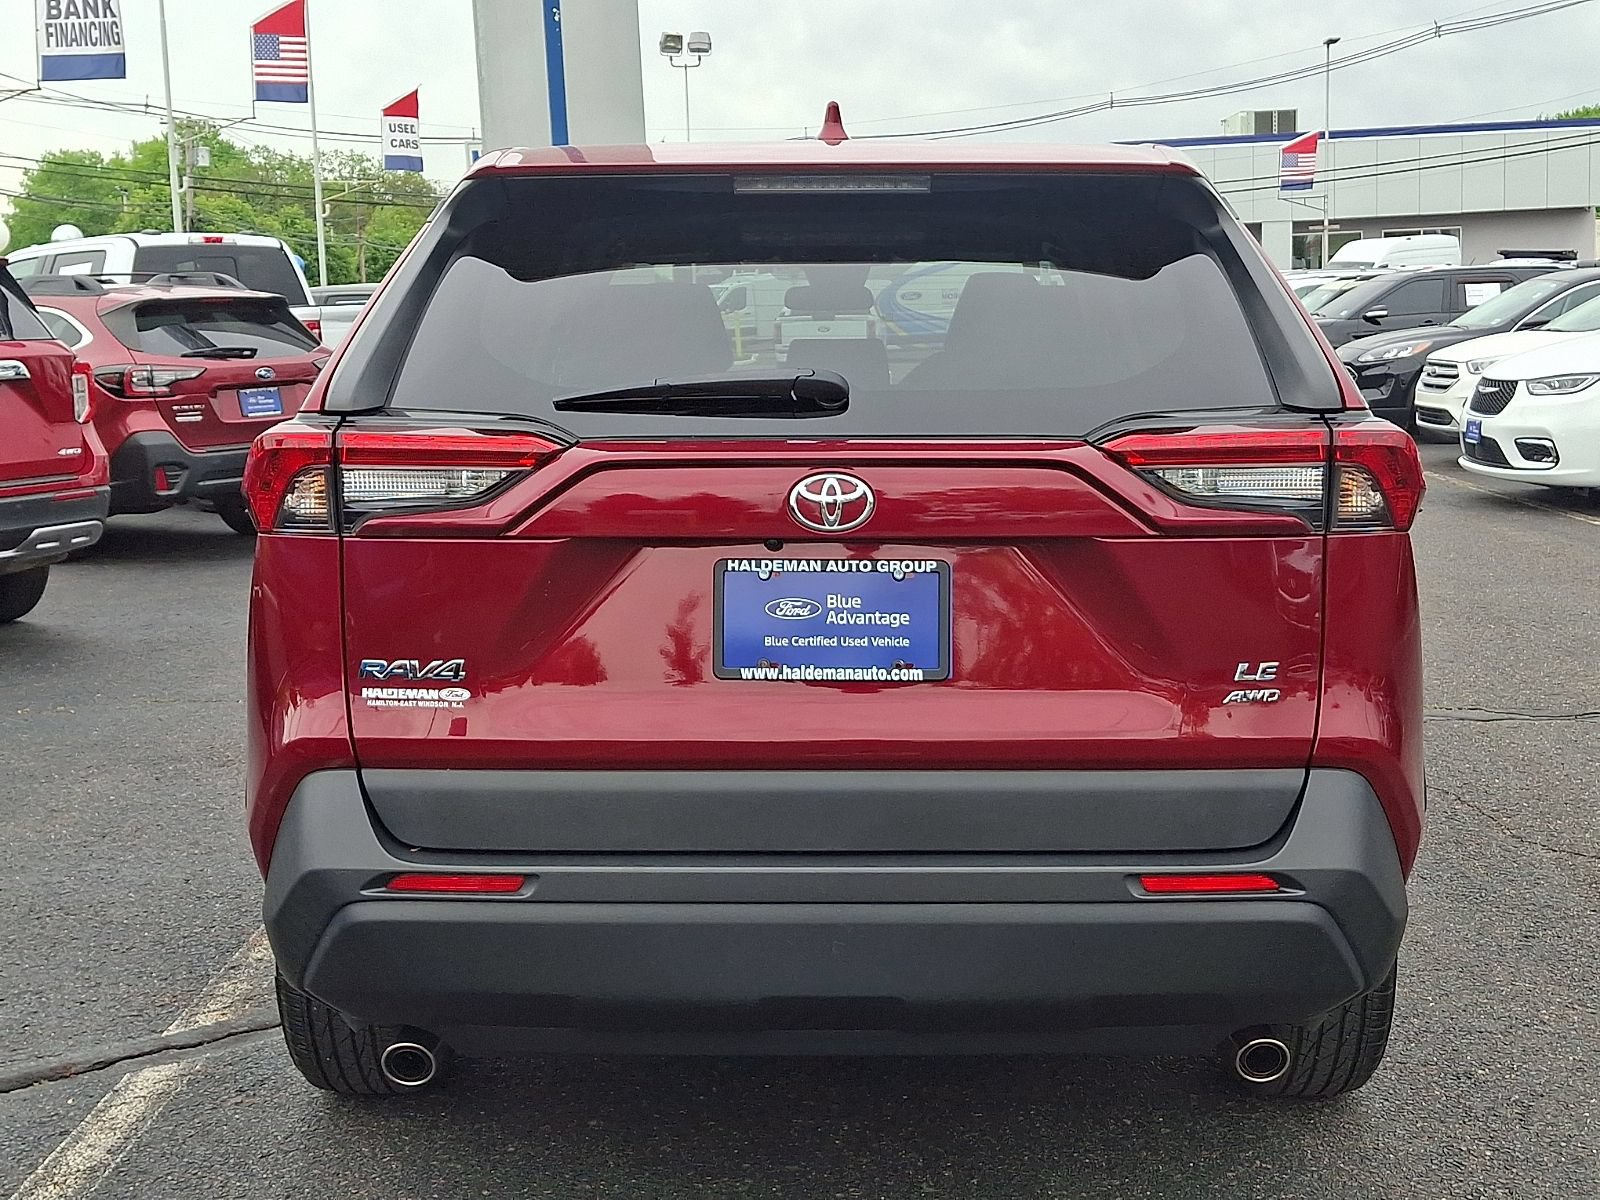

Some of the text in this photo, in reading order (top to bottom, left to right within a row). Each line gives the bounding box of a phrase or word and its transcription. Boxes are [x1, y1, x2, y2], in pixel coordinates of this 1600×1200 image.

[46, 0, 117, 20] BANK
[45, 20, 121, 48] FINANCING
[390, 138, 419, 149] CARS
[727, 559, 938, 572] HALDEMAN AUTO GROUP
[775, 600, 811, 616] Ford
[826, 594, 862, 609] Blue
[825, 610, 910, 628] Advantage
[764, 635, 910, 647] Blue Certified Used Vehicle
[359, 658, 466, 682] RAV4
[740, 664, 924, 681] www.haldemanauto.com
[1234, 661, 1280, 682] LE
[361, 687, 439, 700] HALDEMAN
[1222, 688, 1281, 704] AWD
